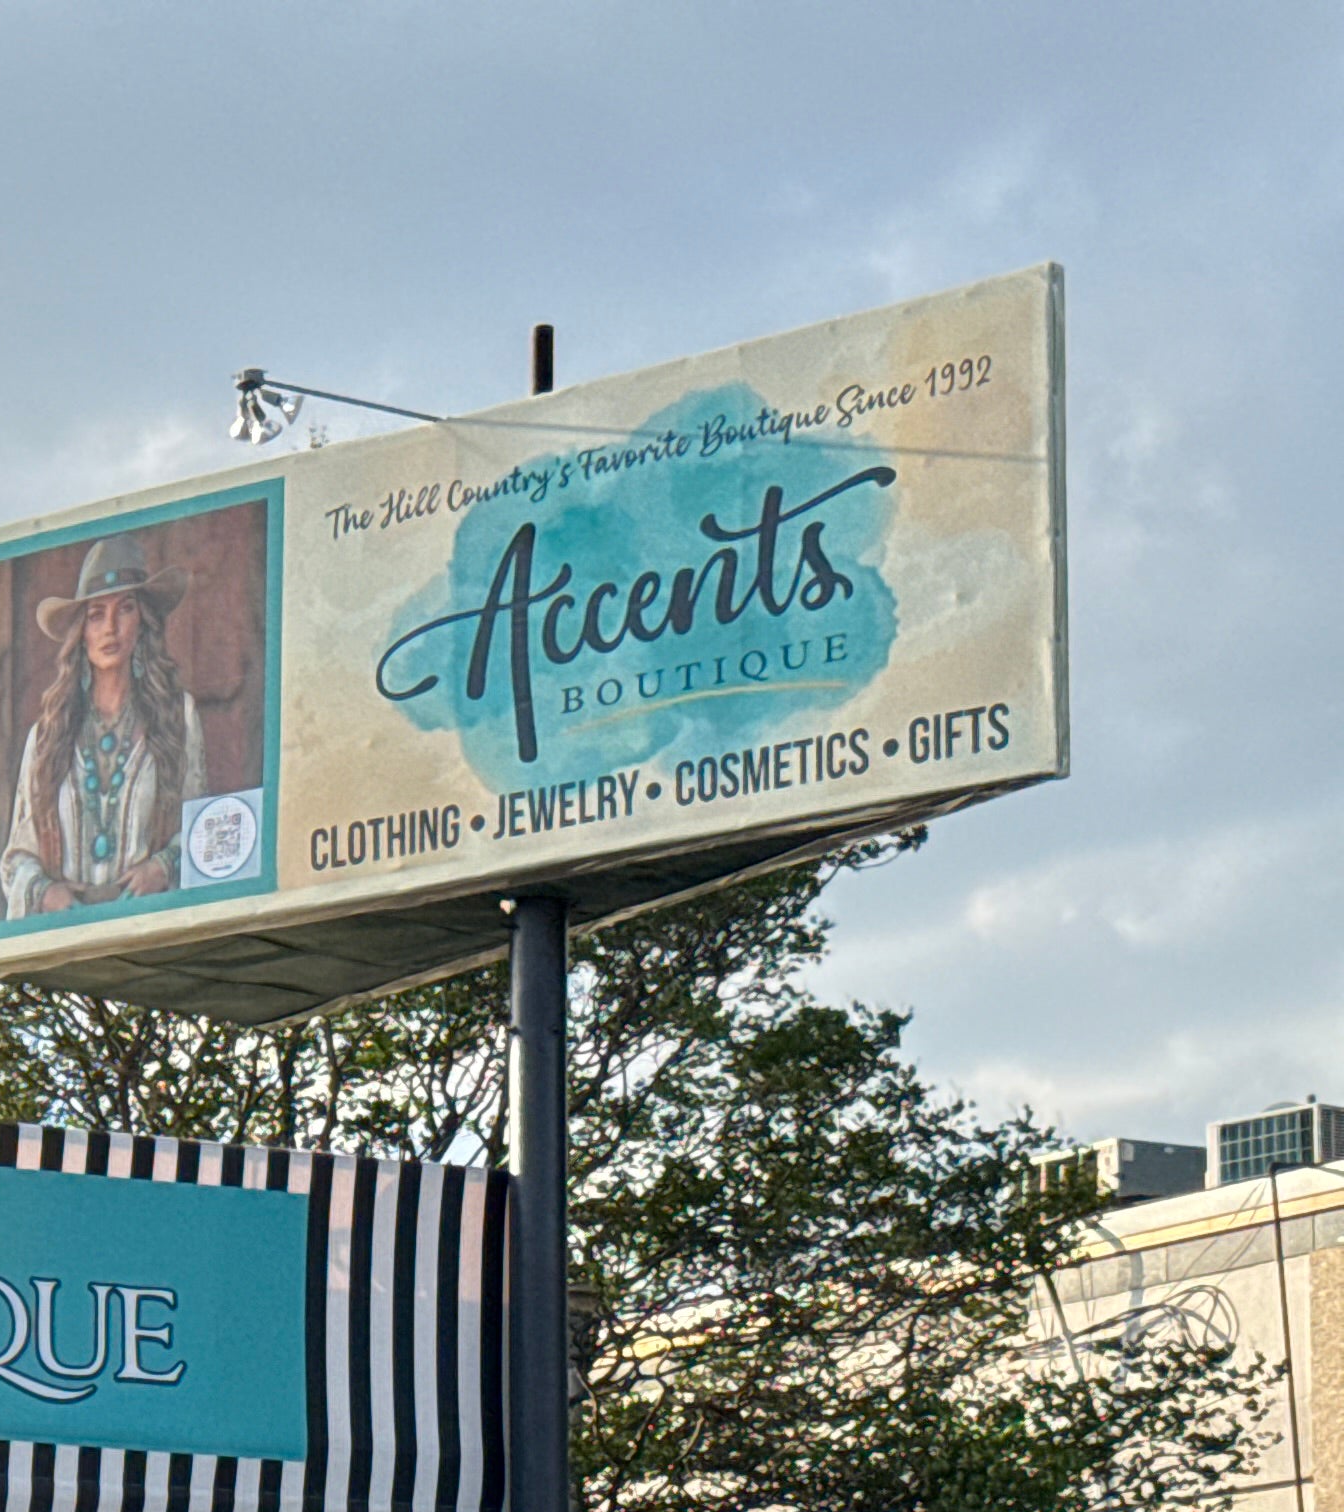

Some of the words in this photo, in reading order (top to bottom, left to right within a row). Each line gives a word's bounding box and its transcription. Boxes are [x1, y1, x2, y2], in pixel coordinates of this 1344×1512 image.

[325, 505, 374, 540] The
[380, 483, 441, 530] Hill
[447, 456, 571, 510] Country's
[578, 436, 690, 480] Favorite
[698, 406, 828, 457] Boutique
[835, 383, 917, 428] Since
[924, 355, 993, 399] 1992
[376, 467, 896, 763] Accents
[560, 634, 848, 714] BOUTIQUE
[311, 804, 460, 871] CLOTHING
[492, 770, 639, 839] JEWELRY
[675, 728, 869, 806] COSMETICS
[908, 703, 1010, 765] GIFTS
